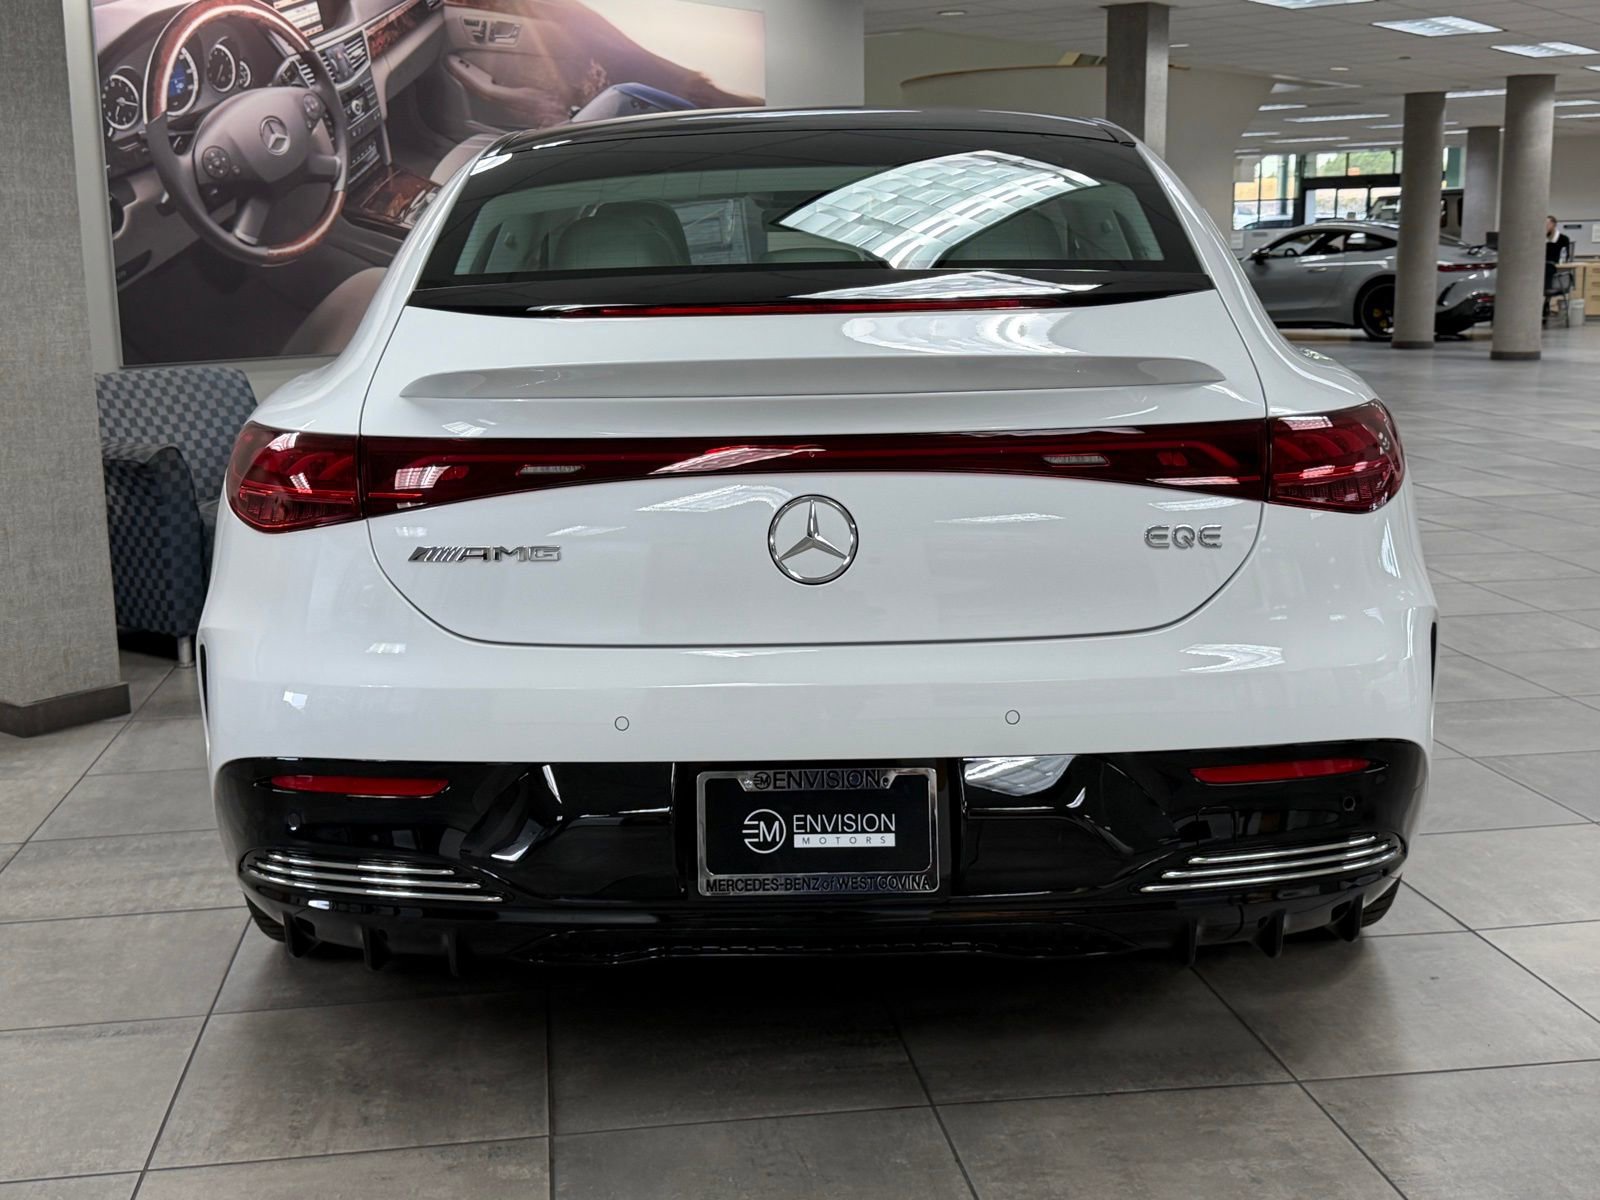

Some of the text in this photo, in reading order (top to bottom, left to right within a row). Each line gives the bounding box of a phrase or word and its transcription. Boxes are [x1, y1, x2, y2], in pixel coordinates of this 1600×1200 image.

[1144, 524, 1222, 549] EQE
[457, 545, 561, 562] AMG
[773, 769, 881, 790] ENVISION
[793, 813, 896, 833] ENVISION
[801, 835, 887, 846] MOTORS
[706, 874, 930, 892] MERCEDES-BENZ of WEST COVINA
